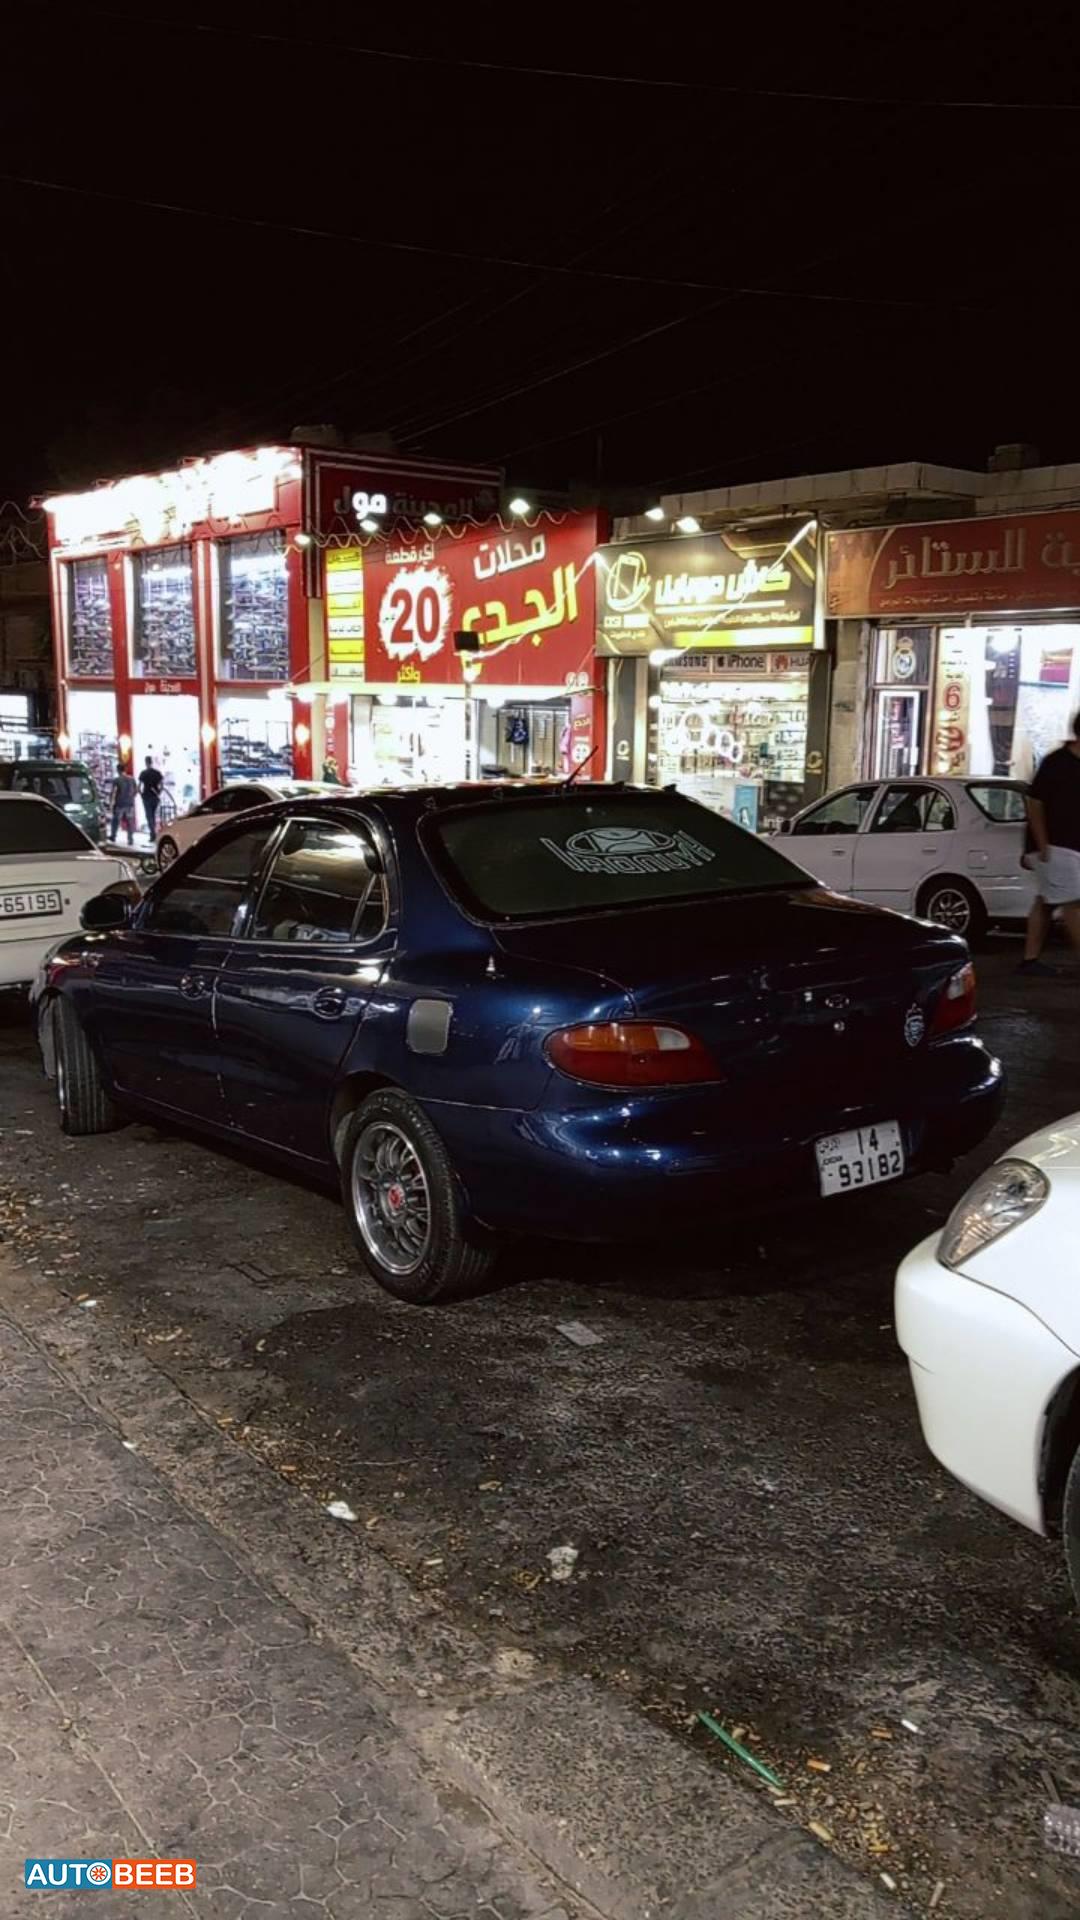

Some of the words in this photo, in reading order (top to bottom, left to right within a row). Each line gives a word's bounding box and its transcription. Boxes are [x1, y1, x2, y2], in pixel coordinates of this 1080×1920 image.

[333, 485, 387, 520] مول
[473, 534, 546, 580] محلات
[390, 586, 440, 644] 20
[727, 654, 765, 668] iPhone
[857, 1128, 879, 1155] 14
